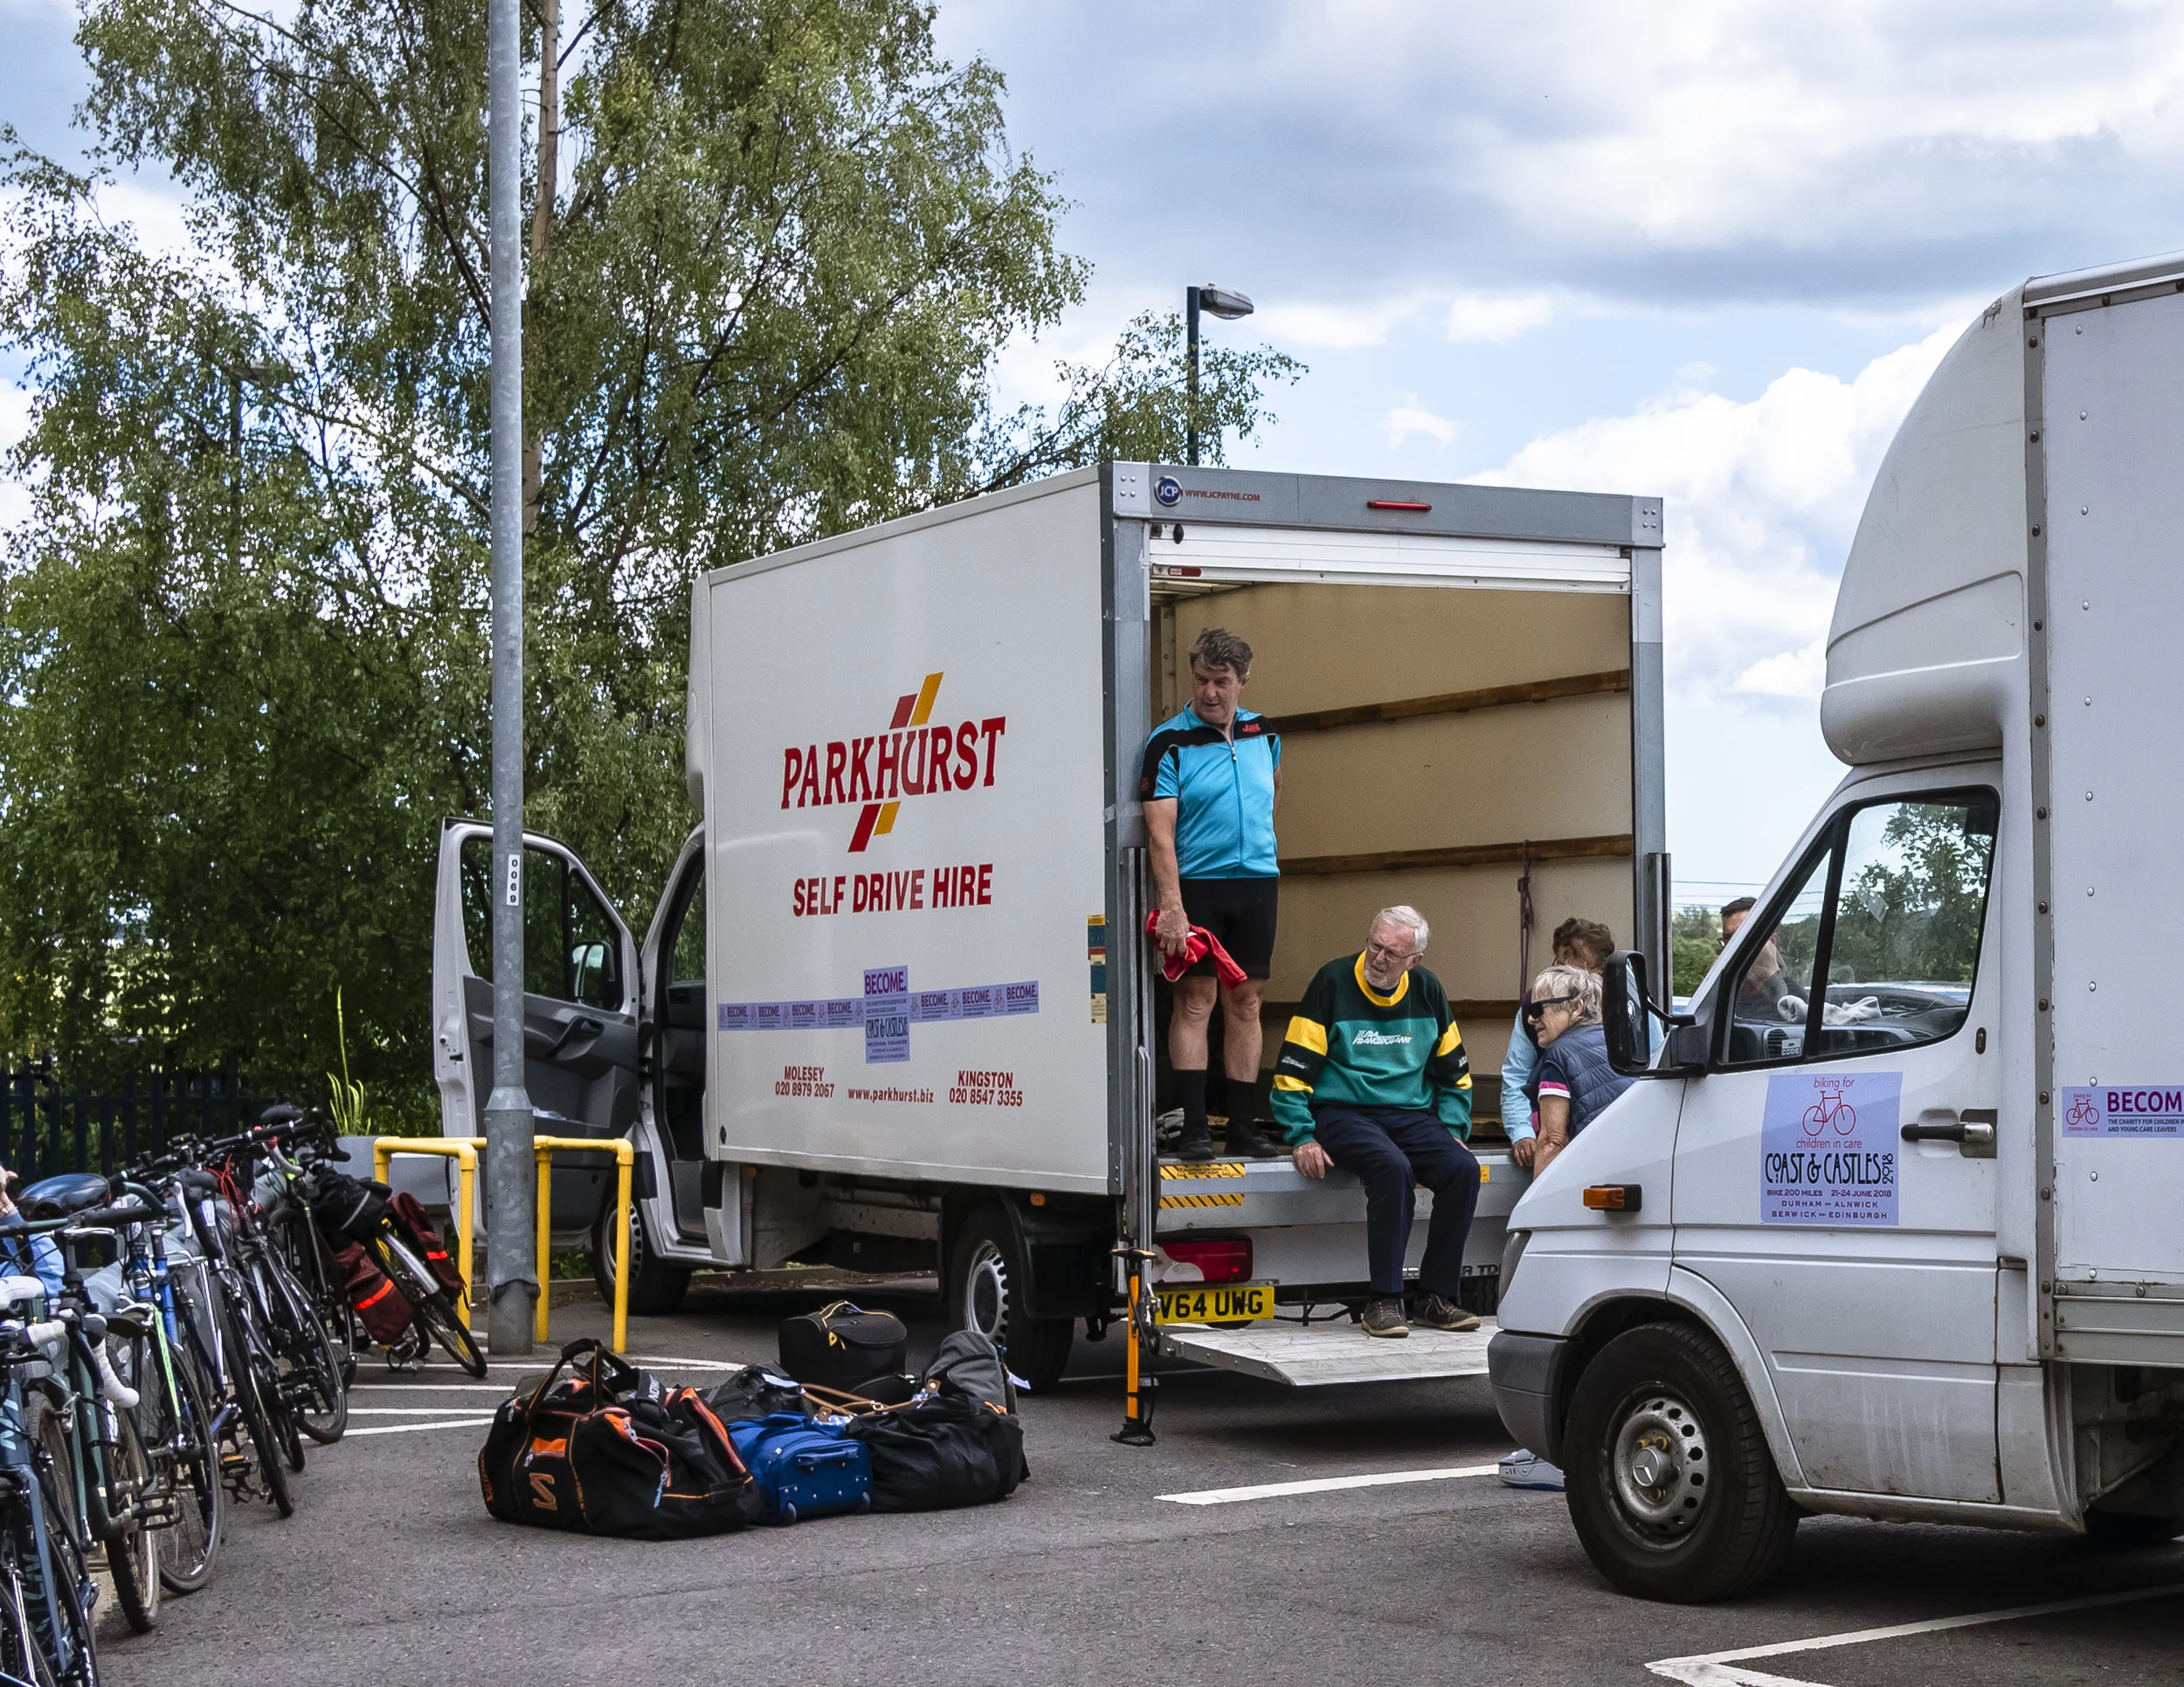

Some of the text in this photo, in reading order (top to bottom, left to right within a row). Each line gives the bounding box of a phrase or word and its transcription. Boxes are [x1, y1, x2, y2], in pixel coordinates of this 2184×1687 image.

[1159, 486, 1178, 497] JCP
[1185, 489, 1261, 501] WWW.JCPAYNE.COM
[780, 716, 1006, 810] PARKHURST
[509, 859, 518, 903] 0069
[792, 863, 994, 916] SELF DRIVE HIRE
[865, 971, 907, 995] BECOME.
[784, 1066, 825, 1082] MOLESEY
[957, 1070, 1013, 1089] KINGSTON
[1813, 1075, 1856, 1090] biking for
[775, 1083, 835, 1098] 020 8979 2067
[847, 1087, 935, 1103] www.parkhurst.biz
[949, 1089, 1023, 1107] 020 8547 3355
[2107, 1091, 2182, 1112] BECOM
[1795, 1137, 1863, 1149] children in care
[1765, 1152, 1894, 1185] COAST & CASTLES 2018
[1784, 1188, 1800, 1197] 200
[1873, 1189, 1892, 1198] 2018
[1828, 1211, 1888, 1220] EDINBURGH
[1158, 1289, 1263, 1319] V64 UWG
